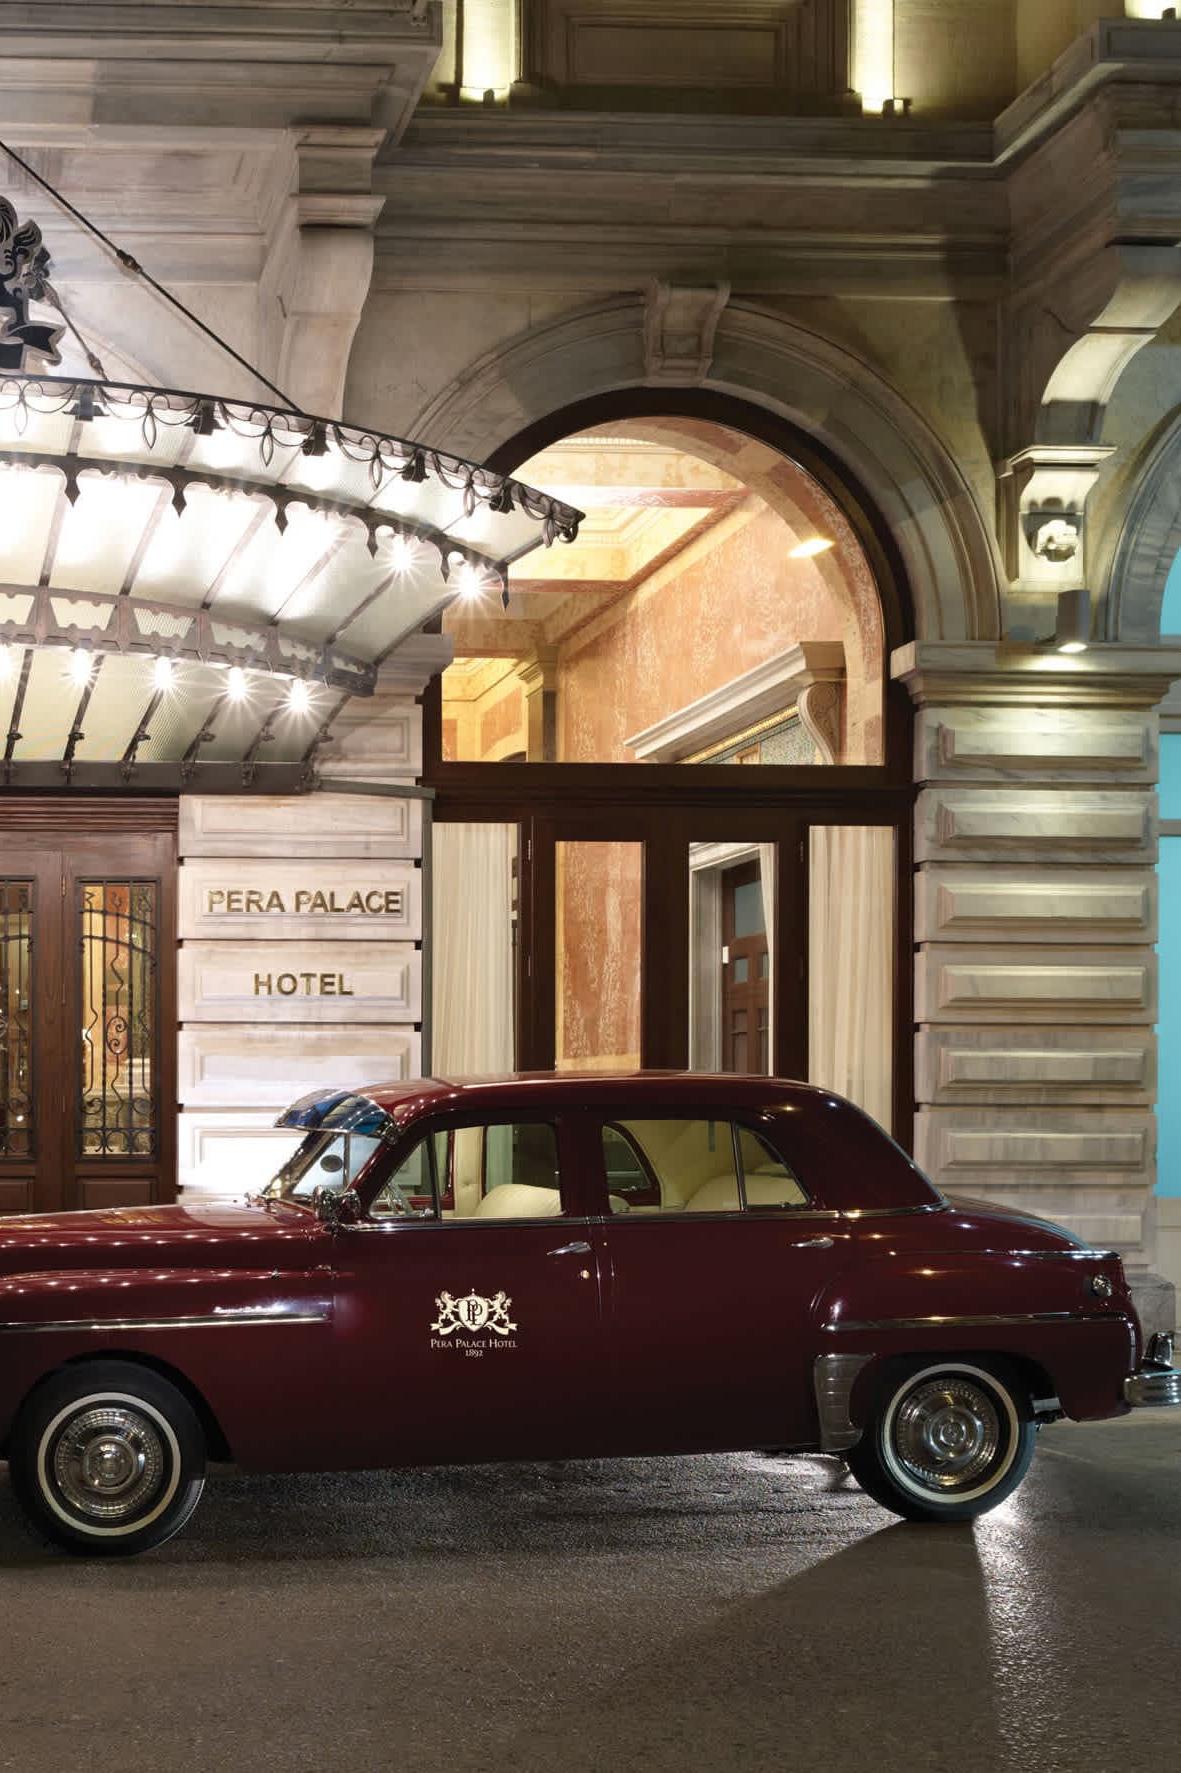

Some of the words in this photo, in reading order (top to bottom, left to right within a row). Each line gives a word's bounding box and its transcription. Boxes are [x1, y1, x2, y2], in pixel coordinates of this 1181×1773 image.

[208, 889, 286, 913] PERA
[294, 889, 402, 914] PALACE
[254, 972, 354, 996] HOTEL
[465, 1349, 484, 1358] 1892
